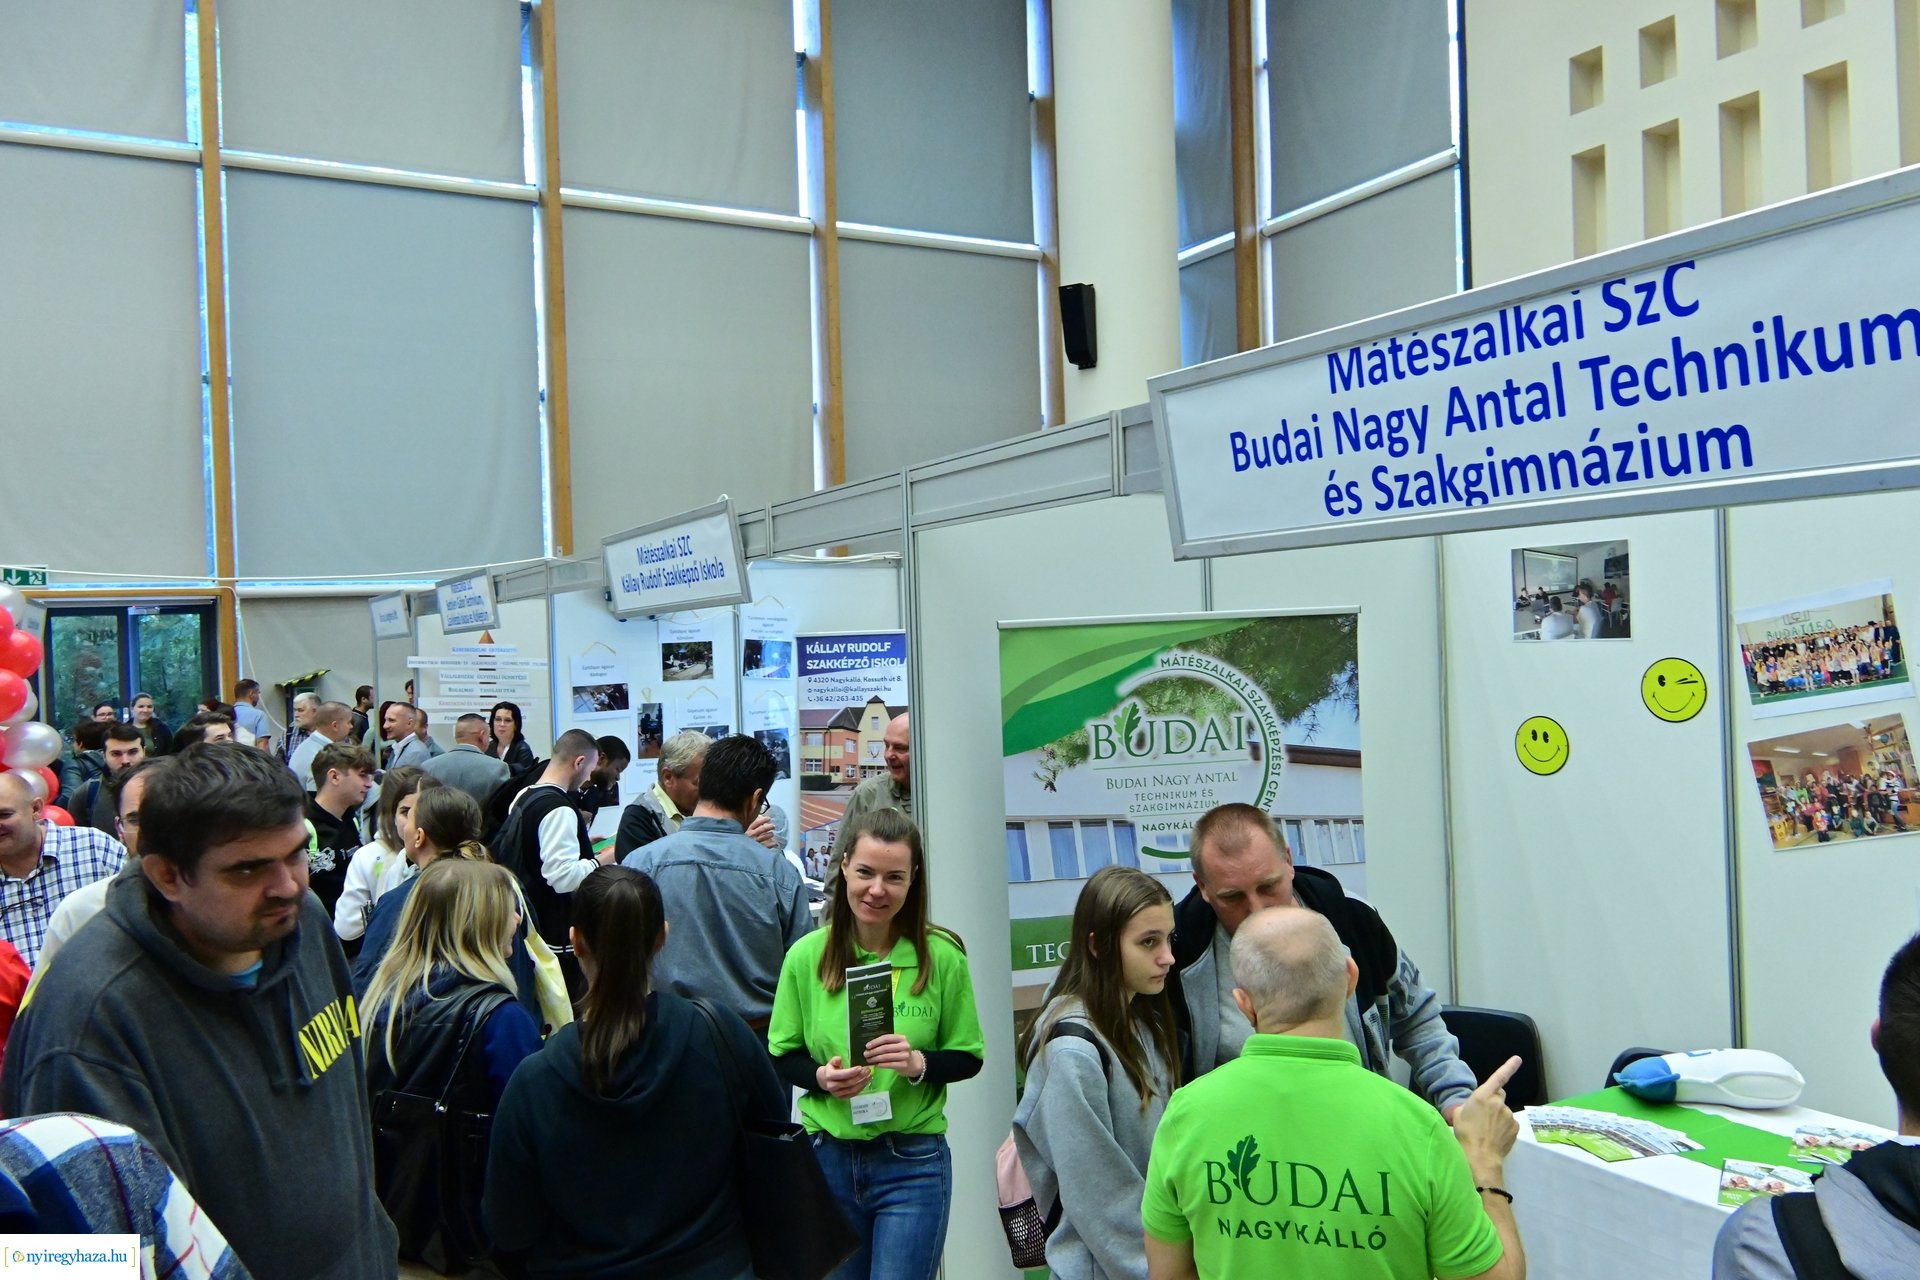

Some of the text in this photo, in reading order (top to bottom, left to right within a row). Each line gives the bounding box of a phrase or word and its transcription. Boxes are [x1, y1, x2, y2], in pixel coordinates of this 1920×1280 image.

[1327, 260, 1700, 394] Mátészalkai SzC
[1230, 308, 1920, 472] Budai Nagy Antal Technikum
[1323, 422, 1754, 517] és Szakgimnázium
[636, 538, 678, 566] Mátészalkai
[621, 556, 725, 596] Kállay Rudolf Szakképző Iskola
[806, 642, 891, 654] KÁLLAY RUDOLF
[806, 656, 907, 669] SZAKKÉPZŐ ISKOL
[813, 676, 830, 684] 4320
[863, 675, 888, 683] Kossuth
[1160, 653, 1249, 692] MÁTÉSZALKAI
[1247, 689, 1284, 777] SZAKKÉPZÉSI
[1091, 716, 1248, 761] BUDAI
[1106, 772, 1239, 791] BUDAI NAGY ANTAL
[1134, 788, 1214, 802] TECHNIKUM ÉS
[1128, 800, 1220, 815] SZAKGIMNÁZIUM
[1203, 1160, 1395, 1218] BUDAI
[1216, 1217, 1387, 1251] NAGYKÁLLÓ
